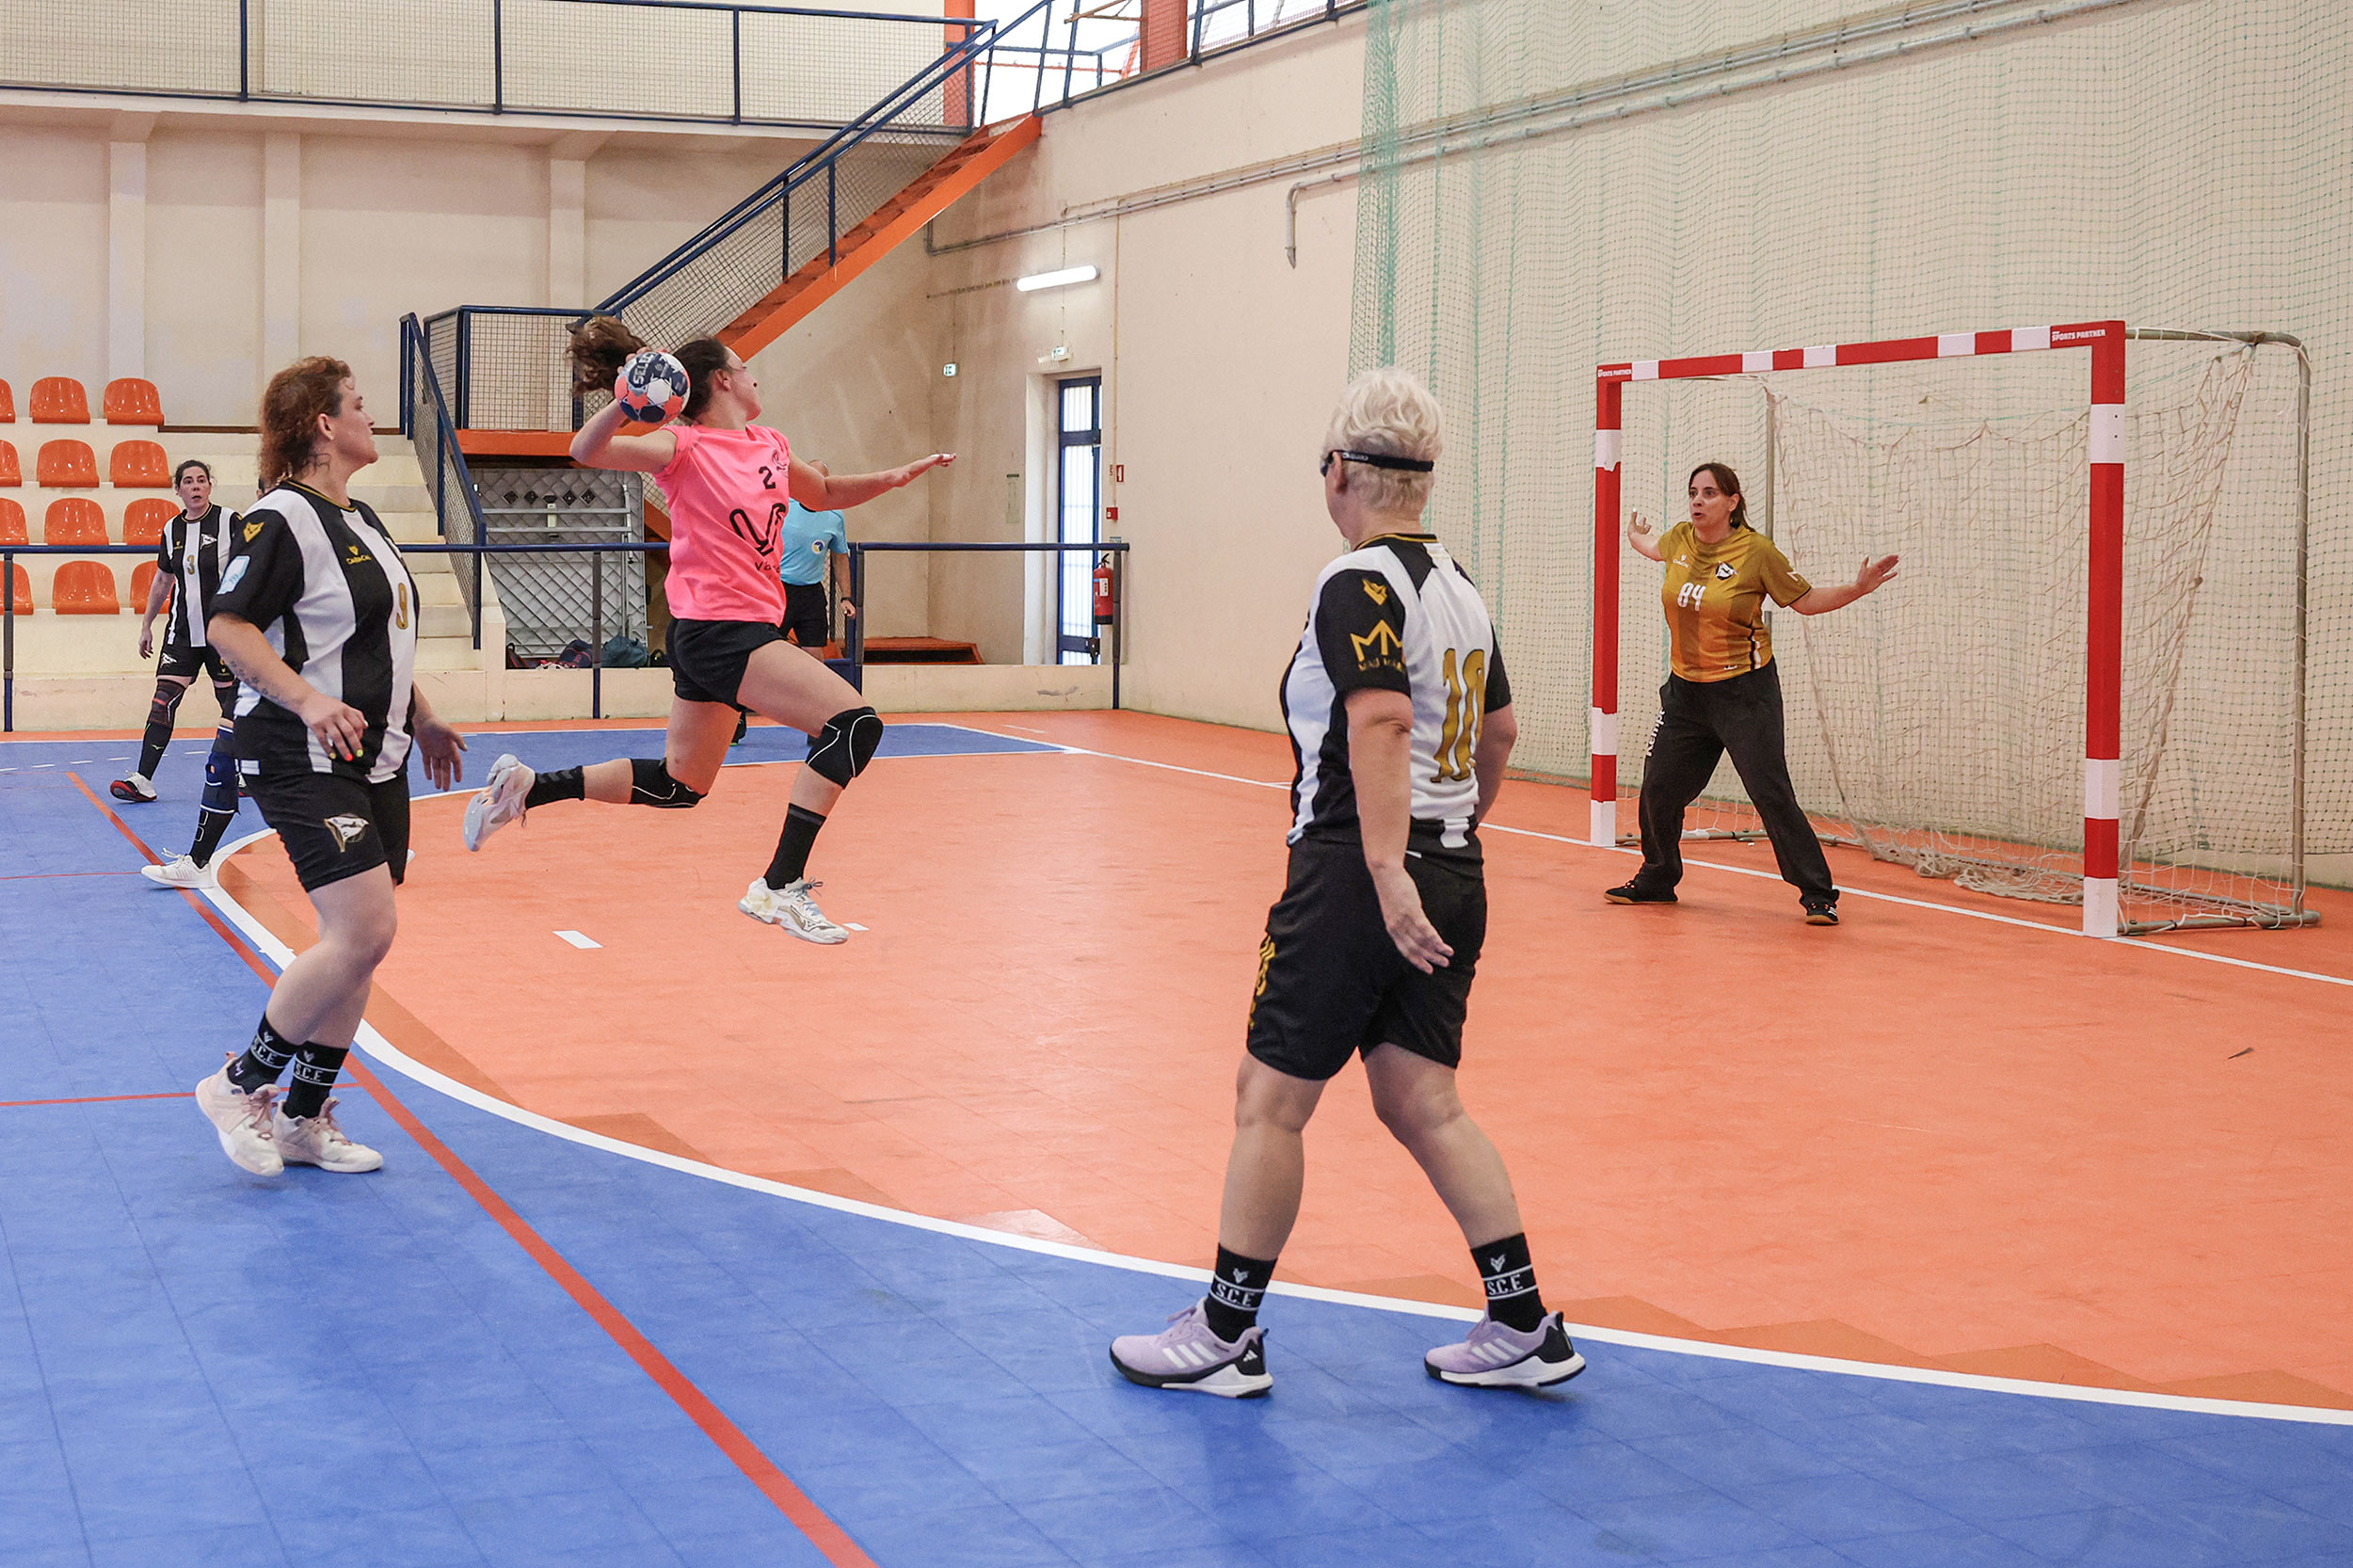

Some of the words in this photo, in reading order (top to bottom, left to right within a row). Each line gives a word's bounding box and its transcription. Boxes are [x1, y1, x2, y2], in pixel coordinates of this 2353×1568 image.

[759, 466, 776, 489] 2
[186, 554, 195, 575] 3
[396, 583, 408, 630] 9
[1677, 583, 1706, 611] 84
[1430, 648, 1485, 783] 10
